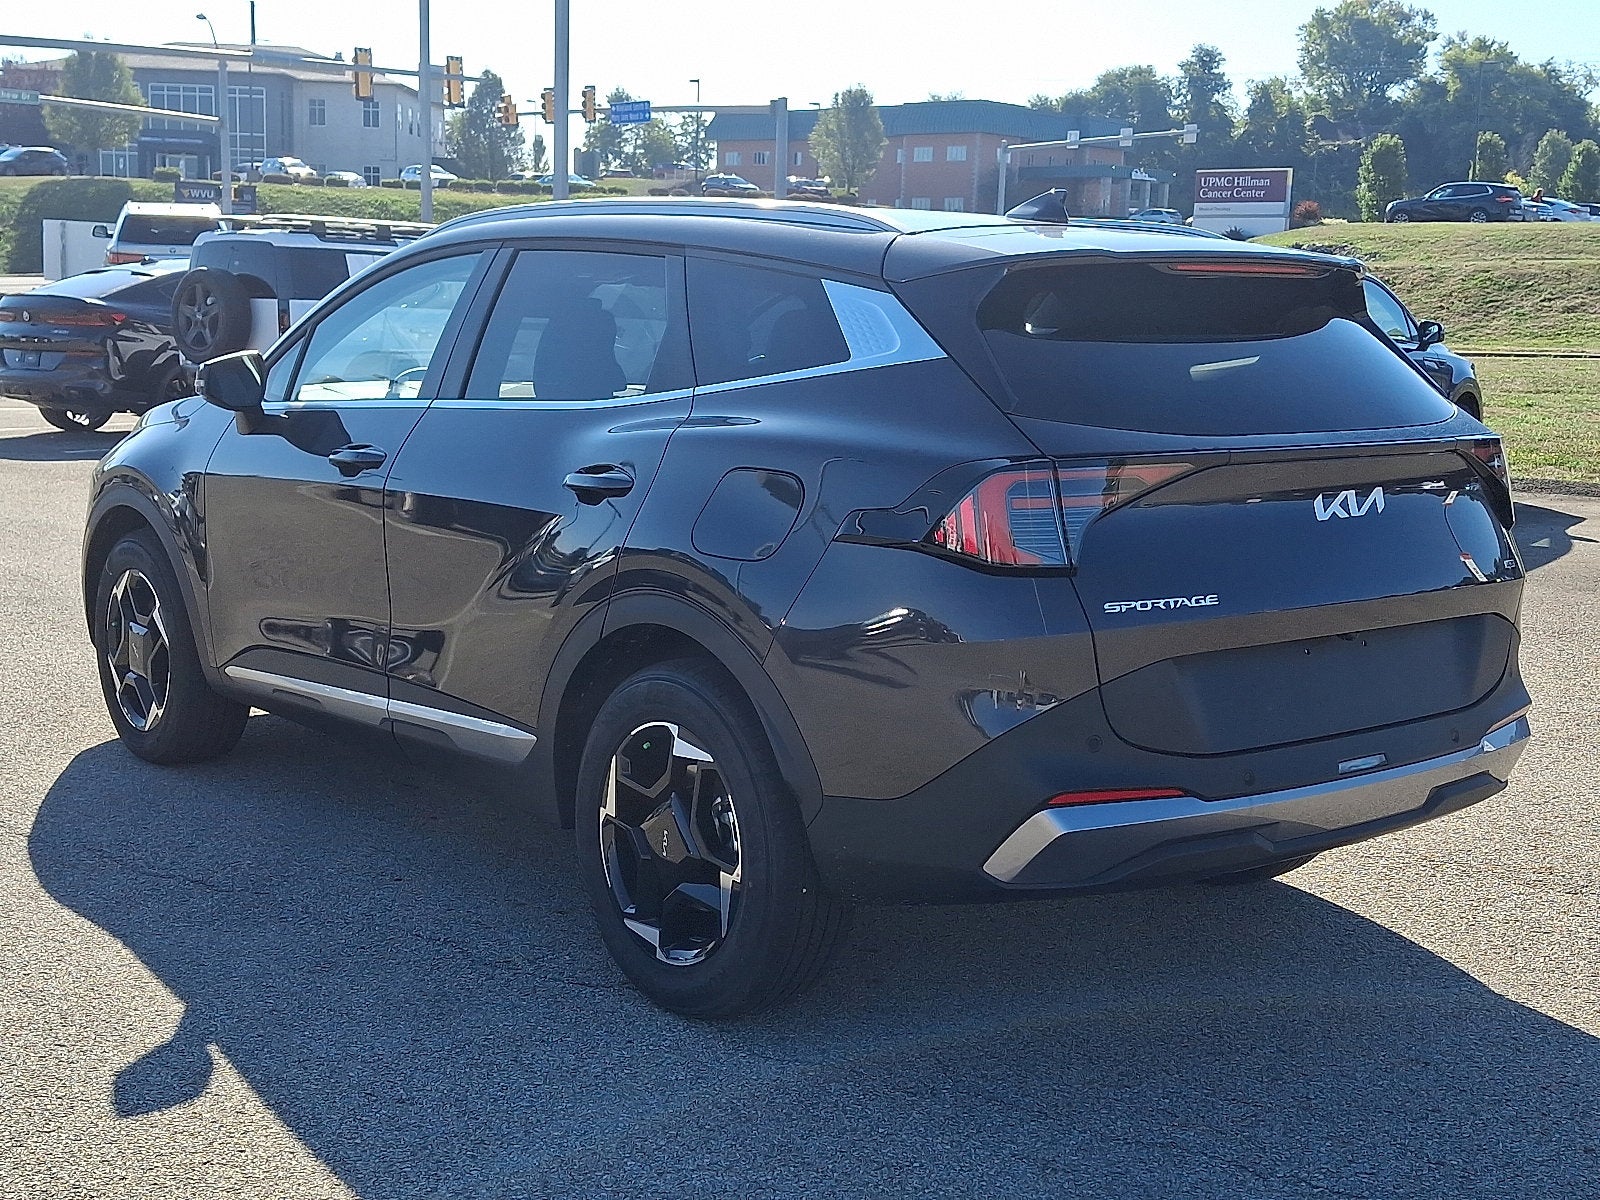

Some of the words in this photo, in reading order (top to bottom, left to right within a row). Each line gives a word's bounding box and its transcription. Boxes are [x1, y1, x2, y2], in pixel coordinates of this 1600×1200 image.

[1200, 175, 1233, 187] UPMC
[1234, 175, 1271, 187] Hillman
[189, 188, 215, 199] WVU
[1199, 188, 1232, 198] Cancer
[1233, 187, 1266, 198] Center
[1313, 486, 1386, 521] KIA
[1103, 594, 1220, 613] SPORTAGE
